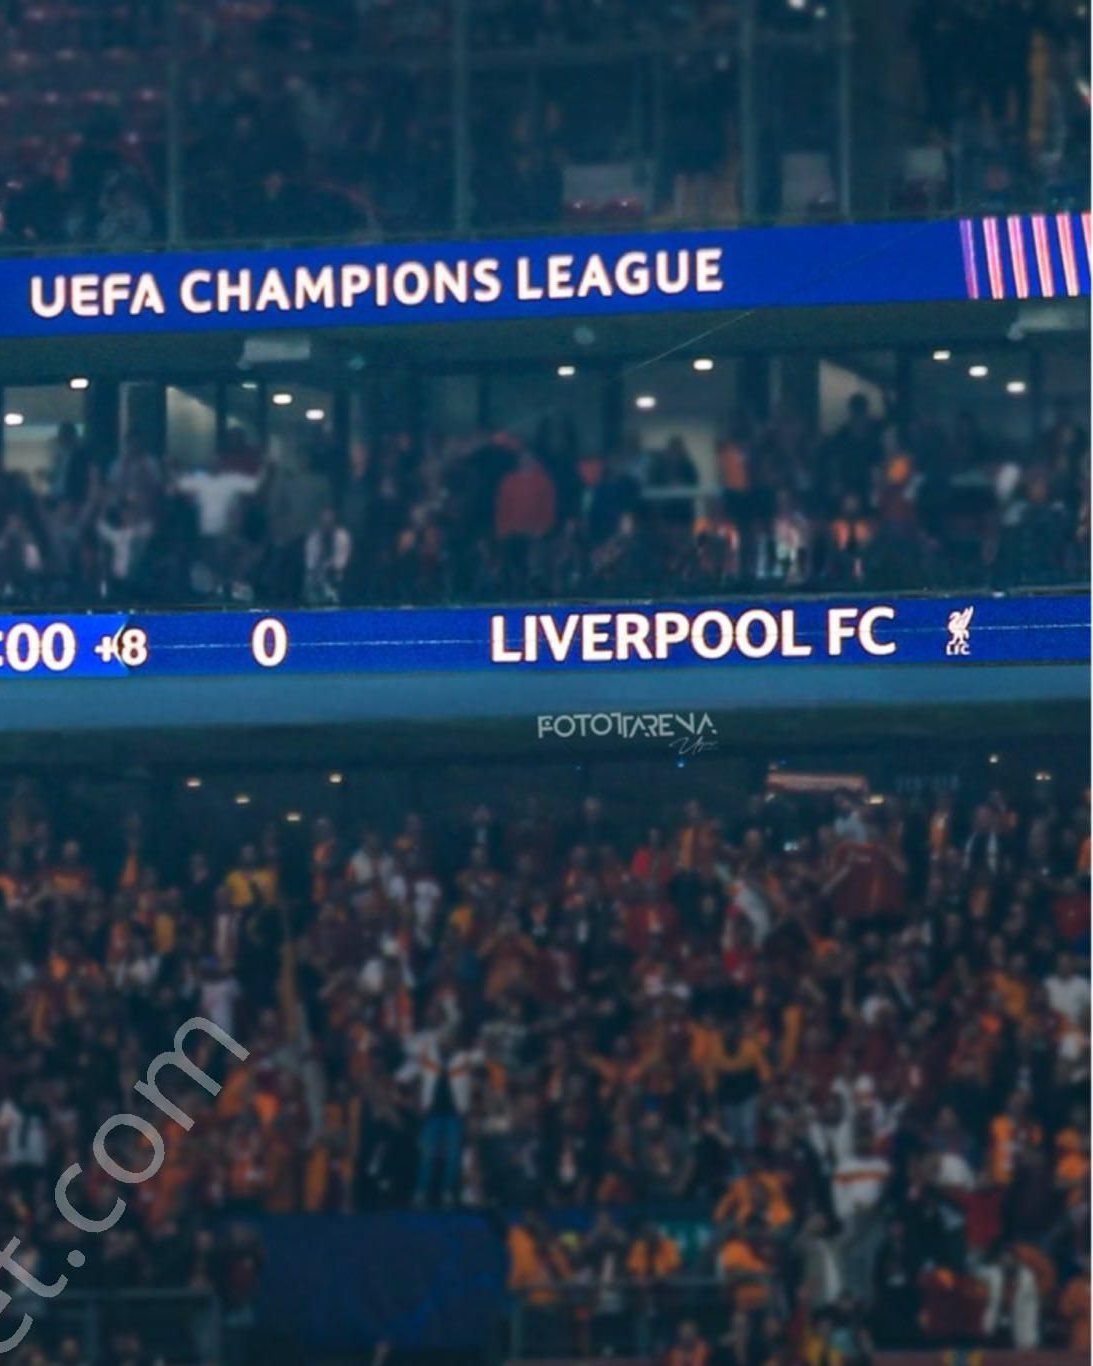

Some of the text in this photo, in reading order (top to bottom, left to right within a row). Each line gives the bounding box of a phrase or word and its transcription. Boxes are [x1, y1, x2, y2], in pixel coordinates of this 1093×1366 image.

[30, 248, 724, 318] UEFA CHAMPIONS LEAGUE
[251, 618, 288, 667] 0
[490, 606, 897, 663] LIVERPOOL FC
[946, 643, 971, 656] LFC
